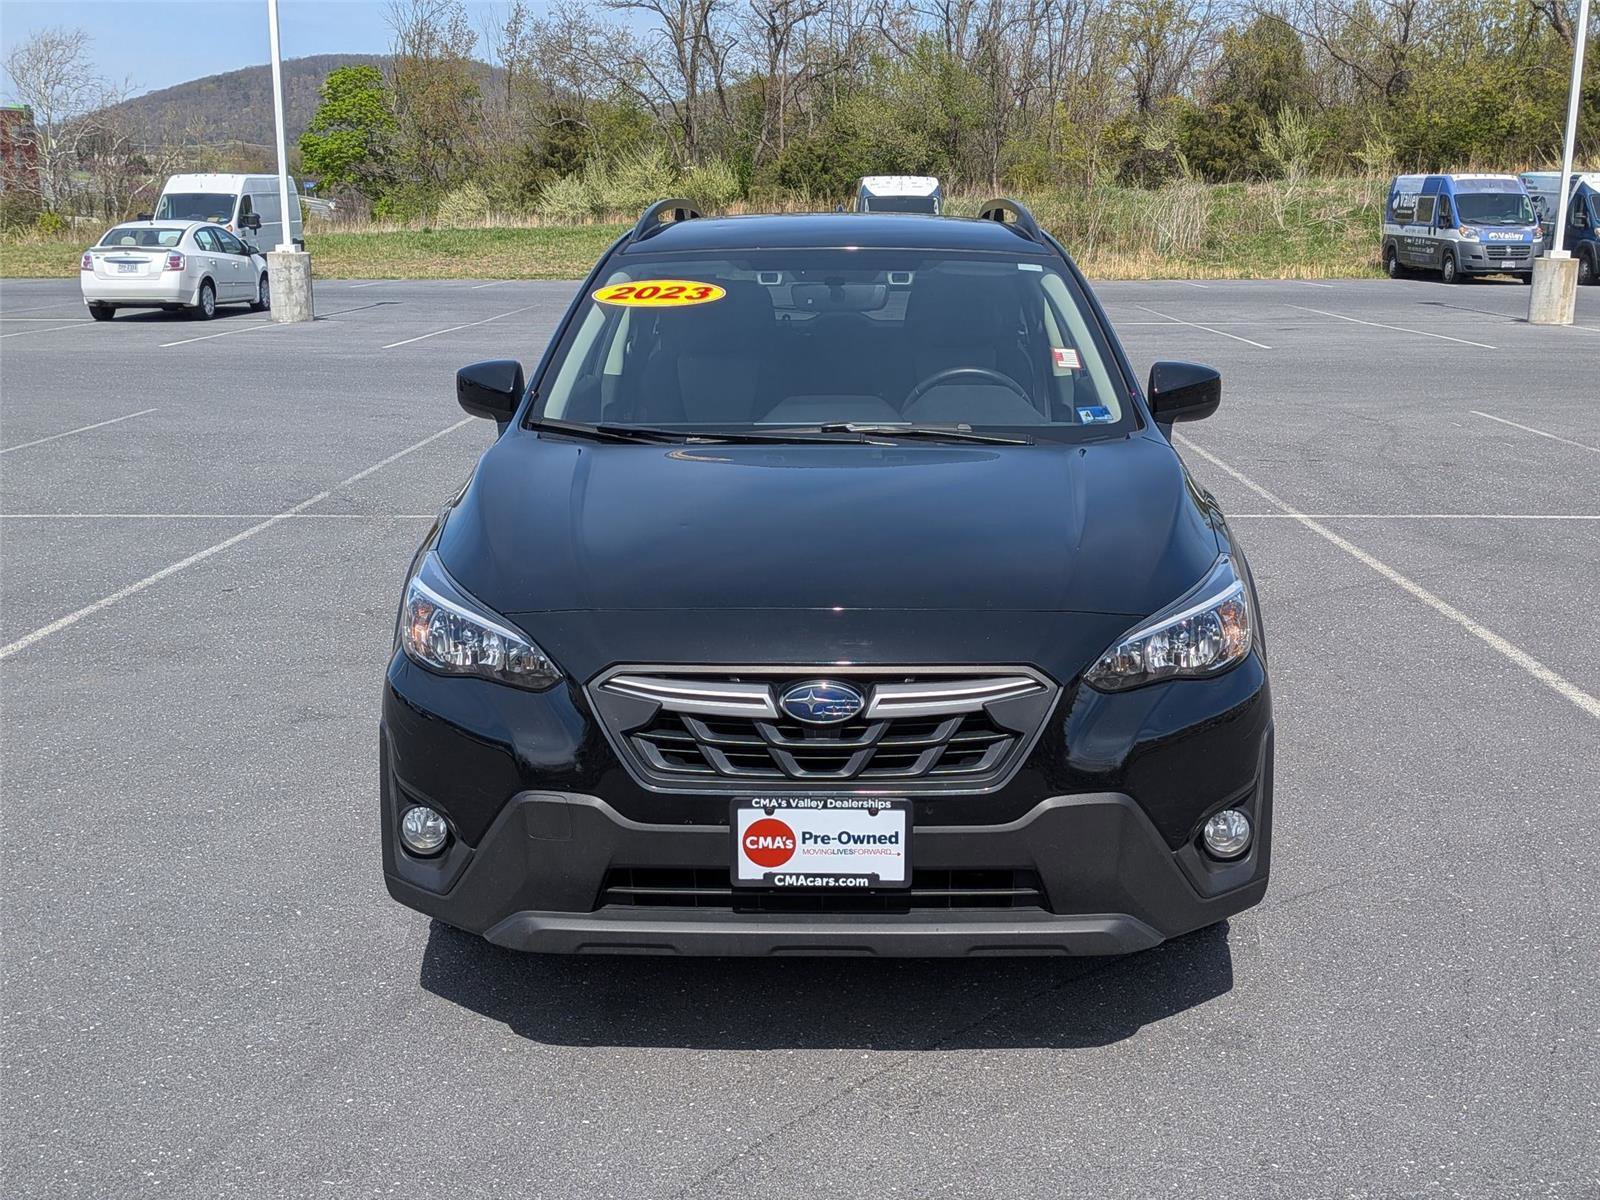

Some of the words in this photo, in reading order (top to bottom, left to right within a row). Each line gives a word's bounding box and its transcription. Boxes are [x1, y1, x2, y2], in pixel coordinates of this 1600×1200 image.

[1498, 232, 1524, 240] Valley
[605, 286, 714, 300] 2023
[752, 798, 787, 808] CMA's
[789, 798, 824, 809] Valley
[827, 799, 891, 809] Dealerships
[745, 836, 794, 850] CMA's
[801, 831, 899, 845] Pre-Owned
[774, 875, 869, 886] CMAcars.com
